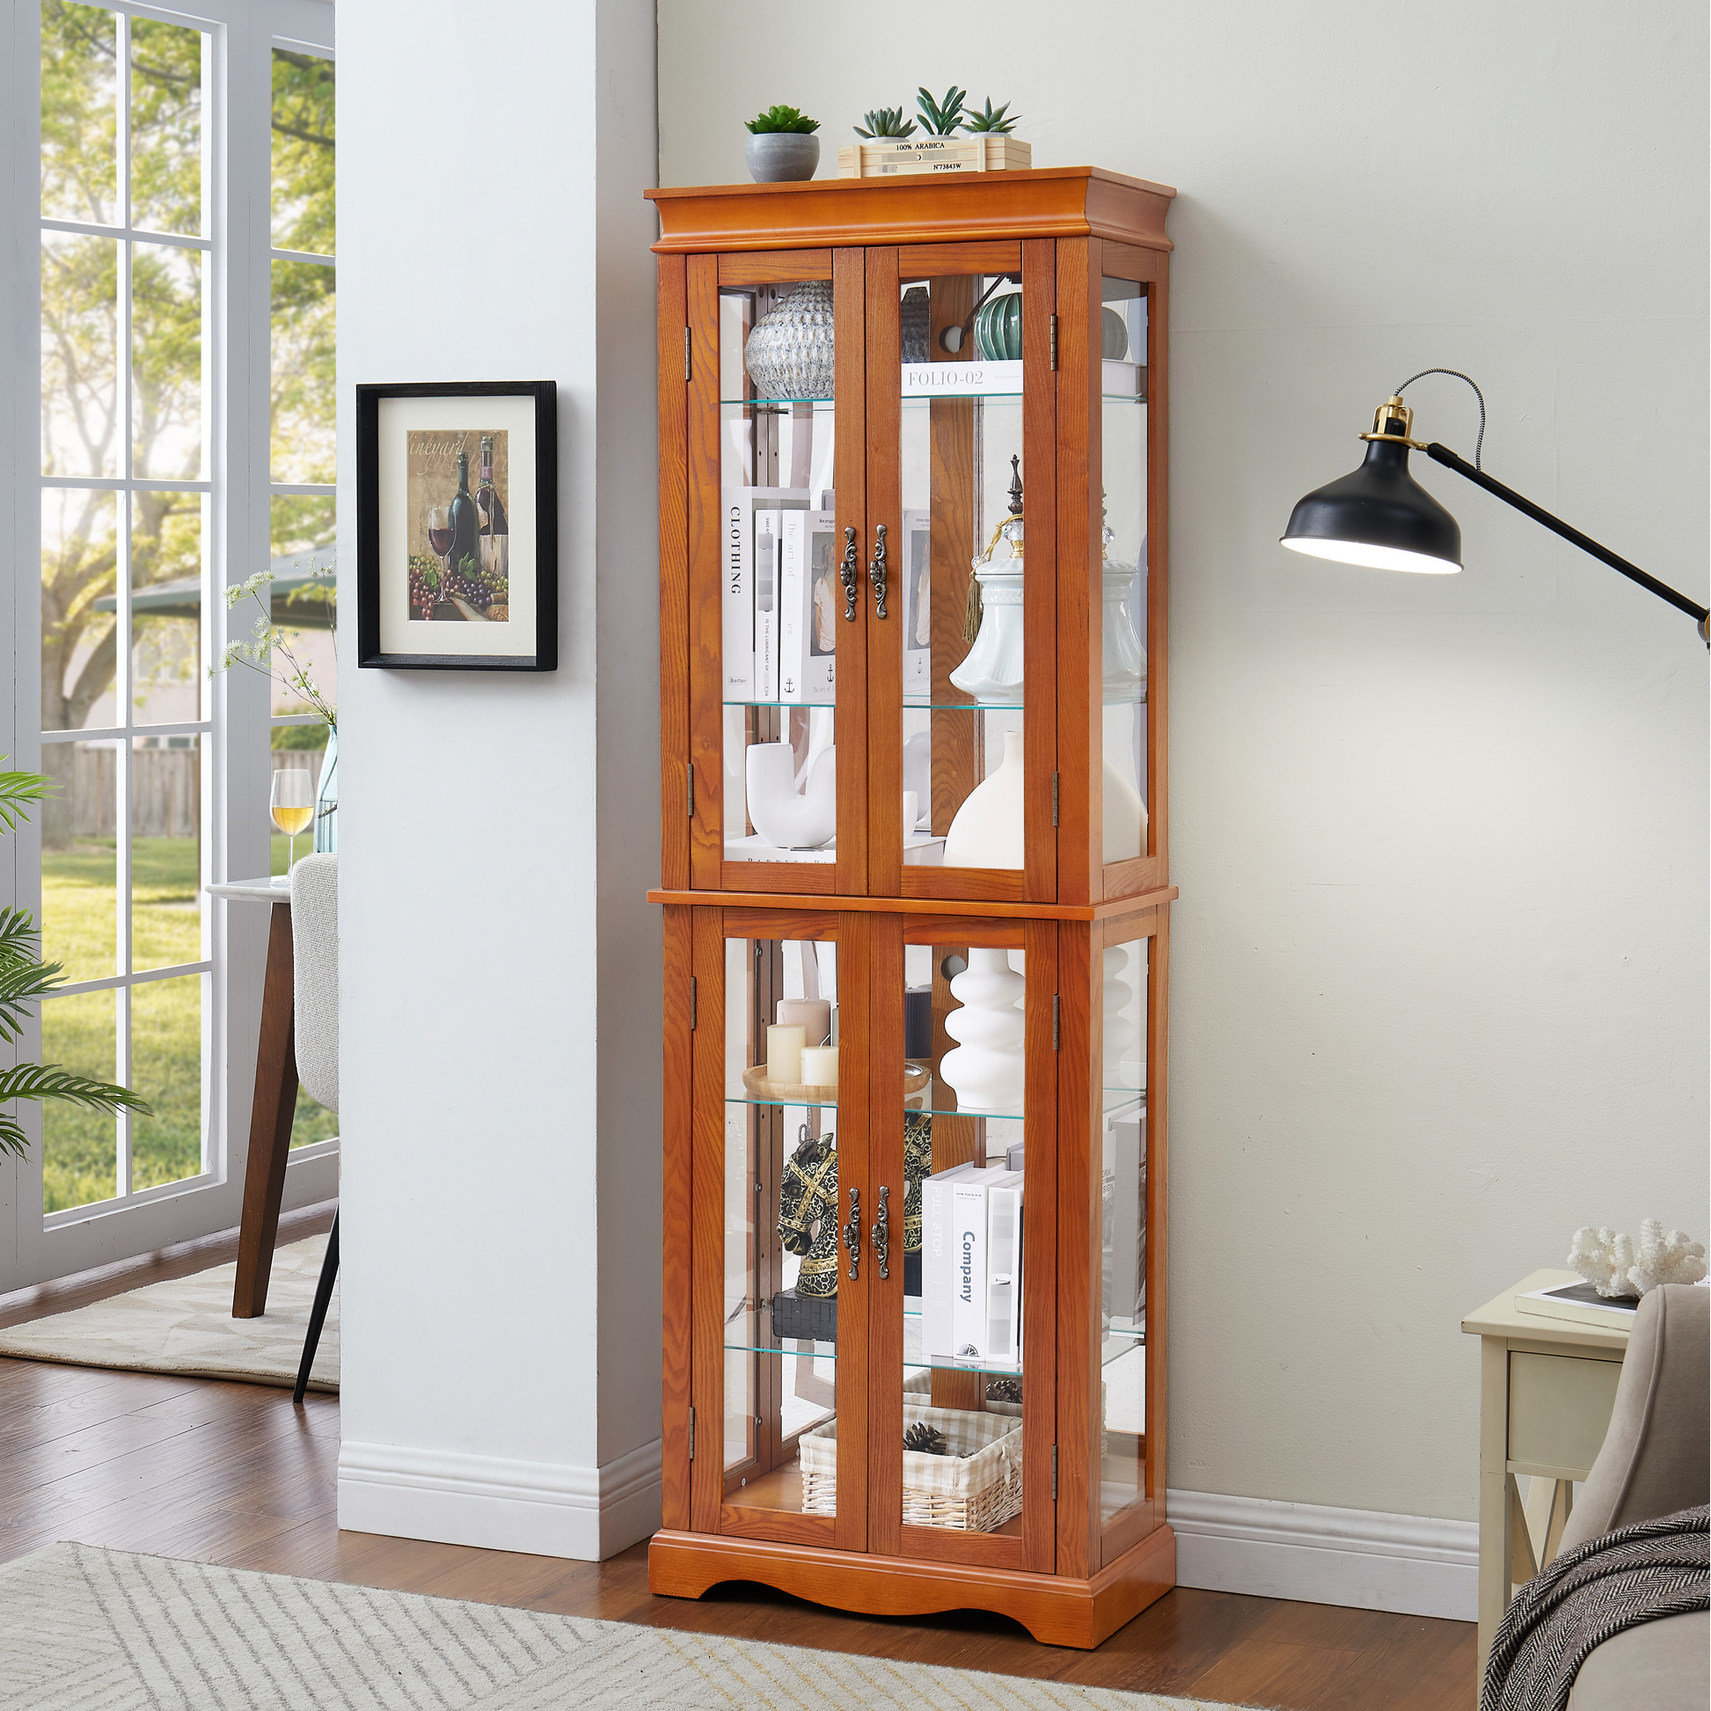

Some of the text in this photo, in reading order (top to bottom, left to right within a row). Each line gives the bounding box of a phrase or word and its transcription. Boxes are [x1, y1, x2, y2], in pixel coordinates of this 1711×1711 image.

[909, 370, 984, 387] FOLIO-02
[730, 506, 741, 594] CLOTHING
[932, 1185, 943, 1218] FULL
[960, 1231, 975, 1303] Company
